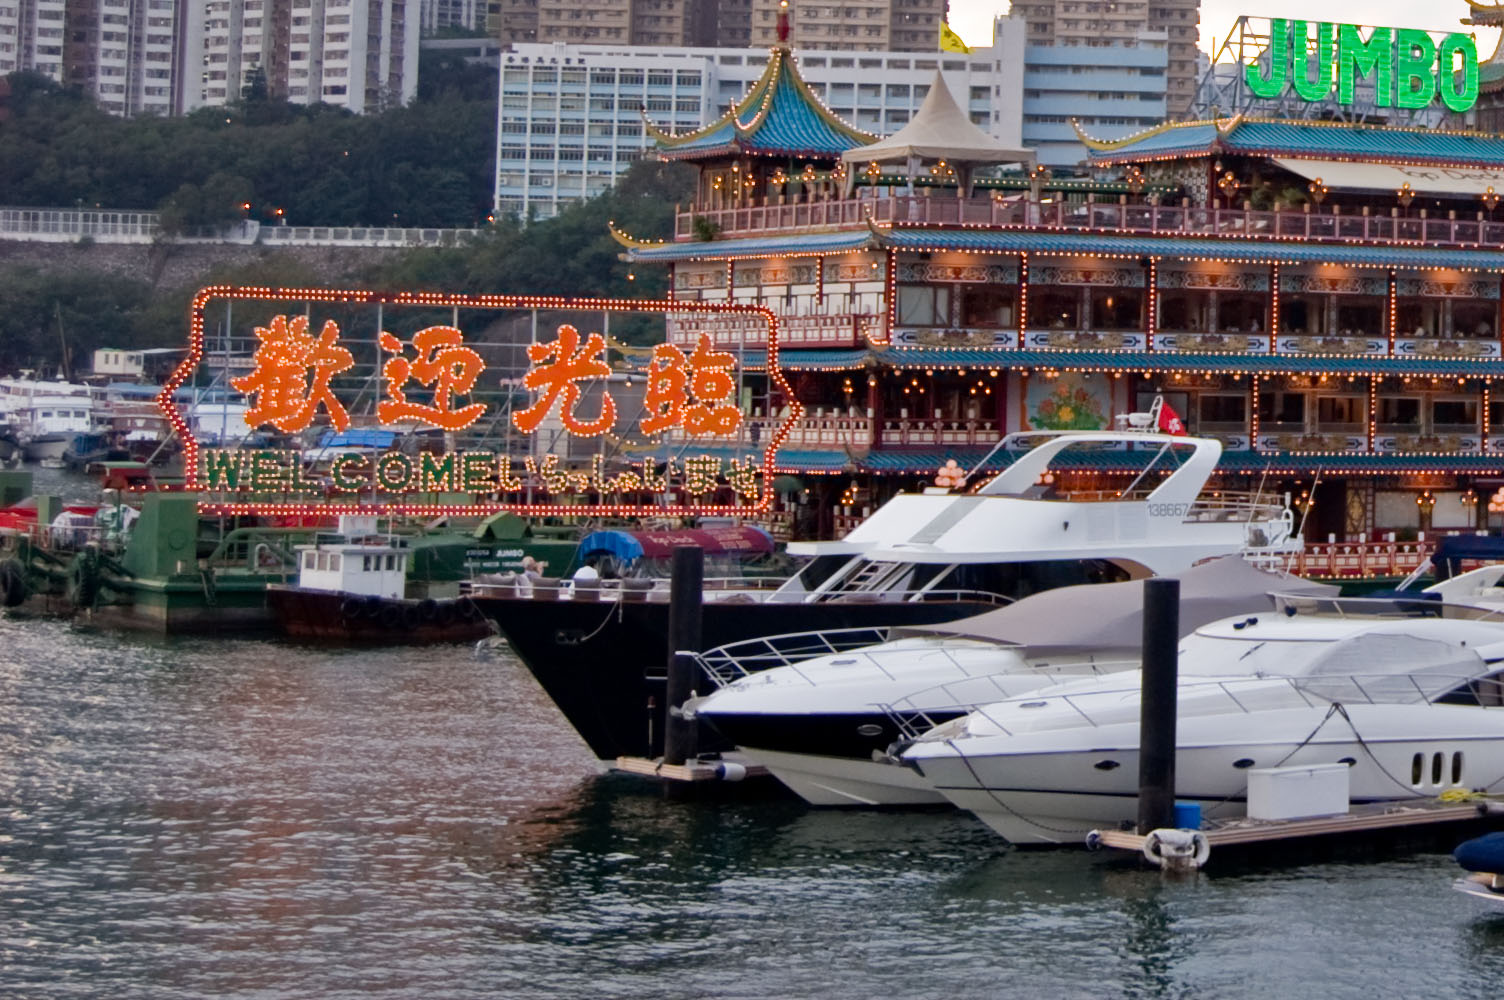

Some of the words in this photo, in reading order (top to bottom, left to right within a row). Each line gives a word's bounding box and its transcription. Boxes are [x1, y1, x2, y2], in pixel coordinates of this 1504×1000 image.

[1246, 17, 1479, 112] JUMBO
[231, 314, 742, 436] 歡迎光臨
[205, 449, 496, 493] WELCOME
